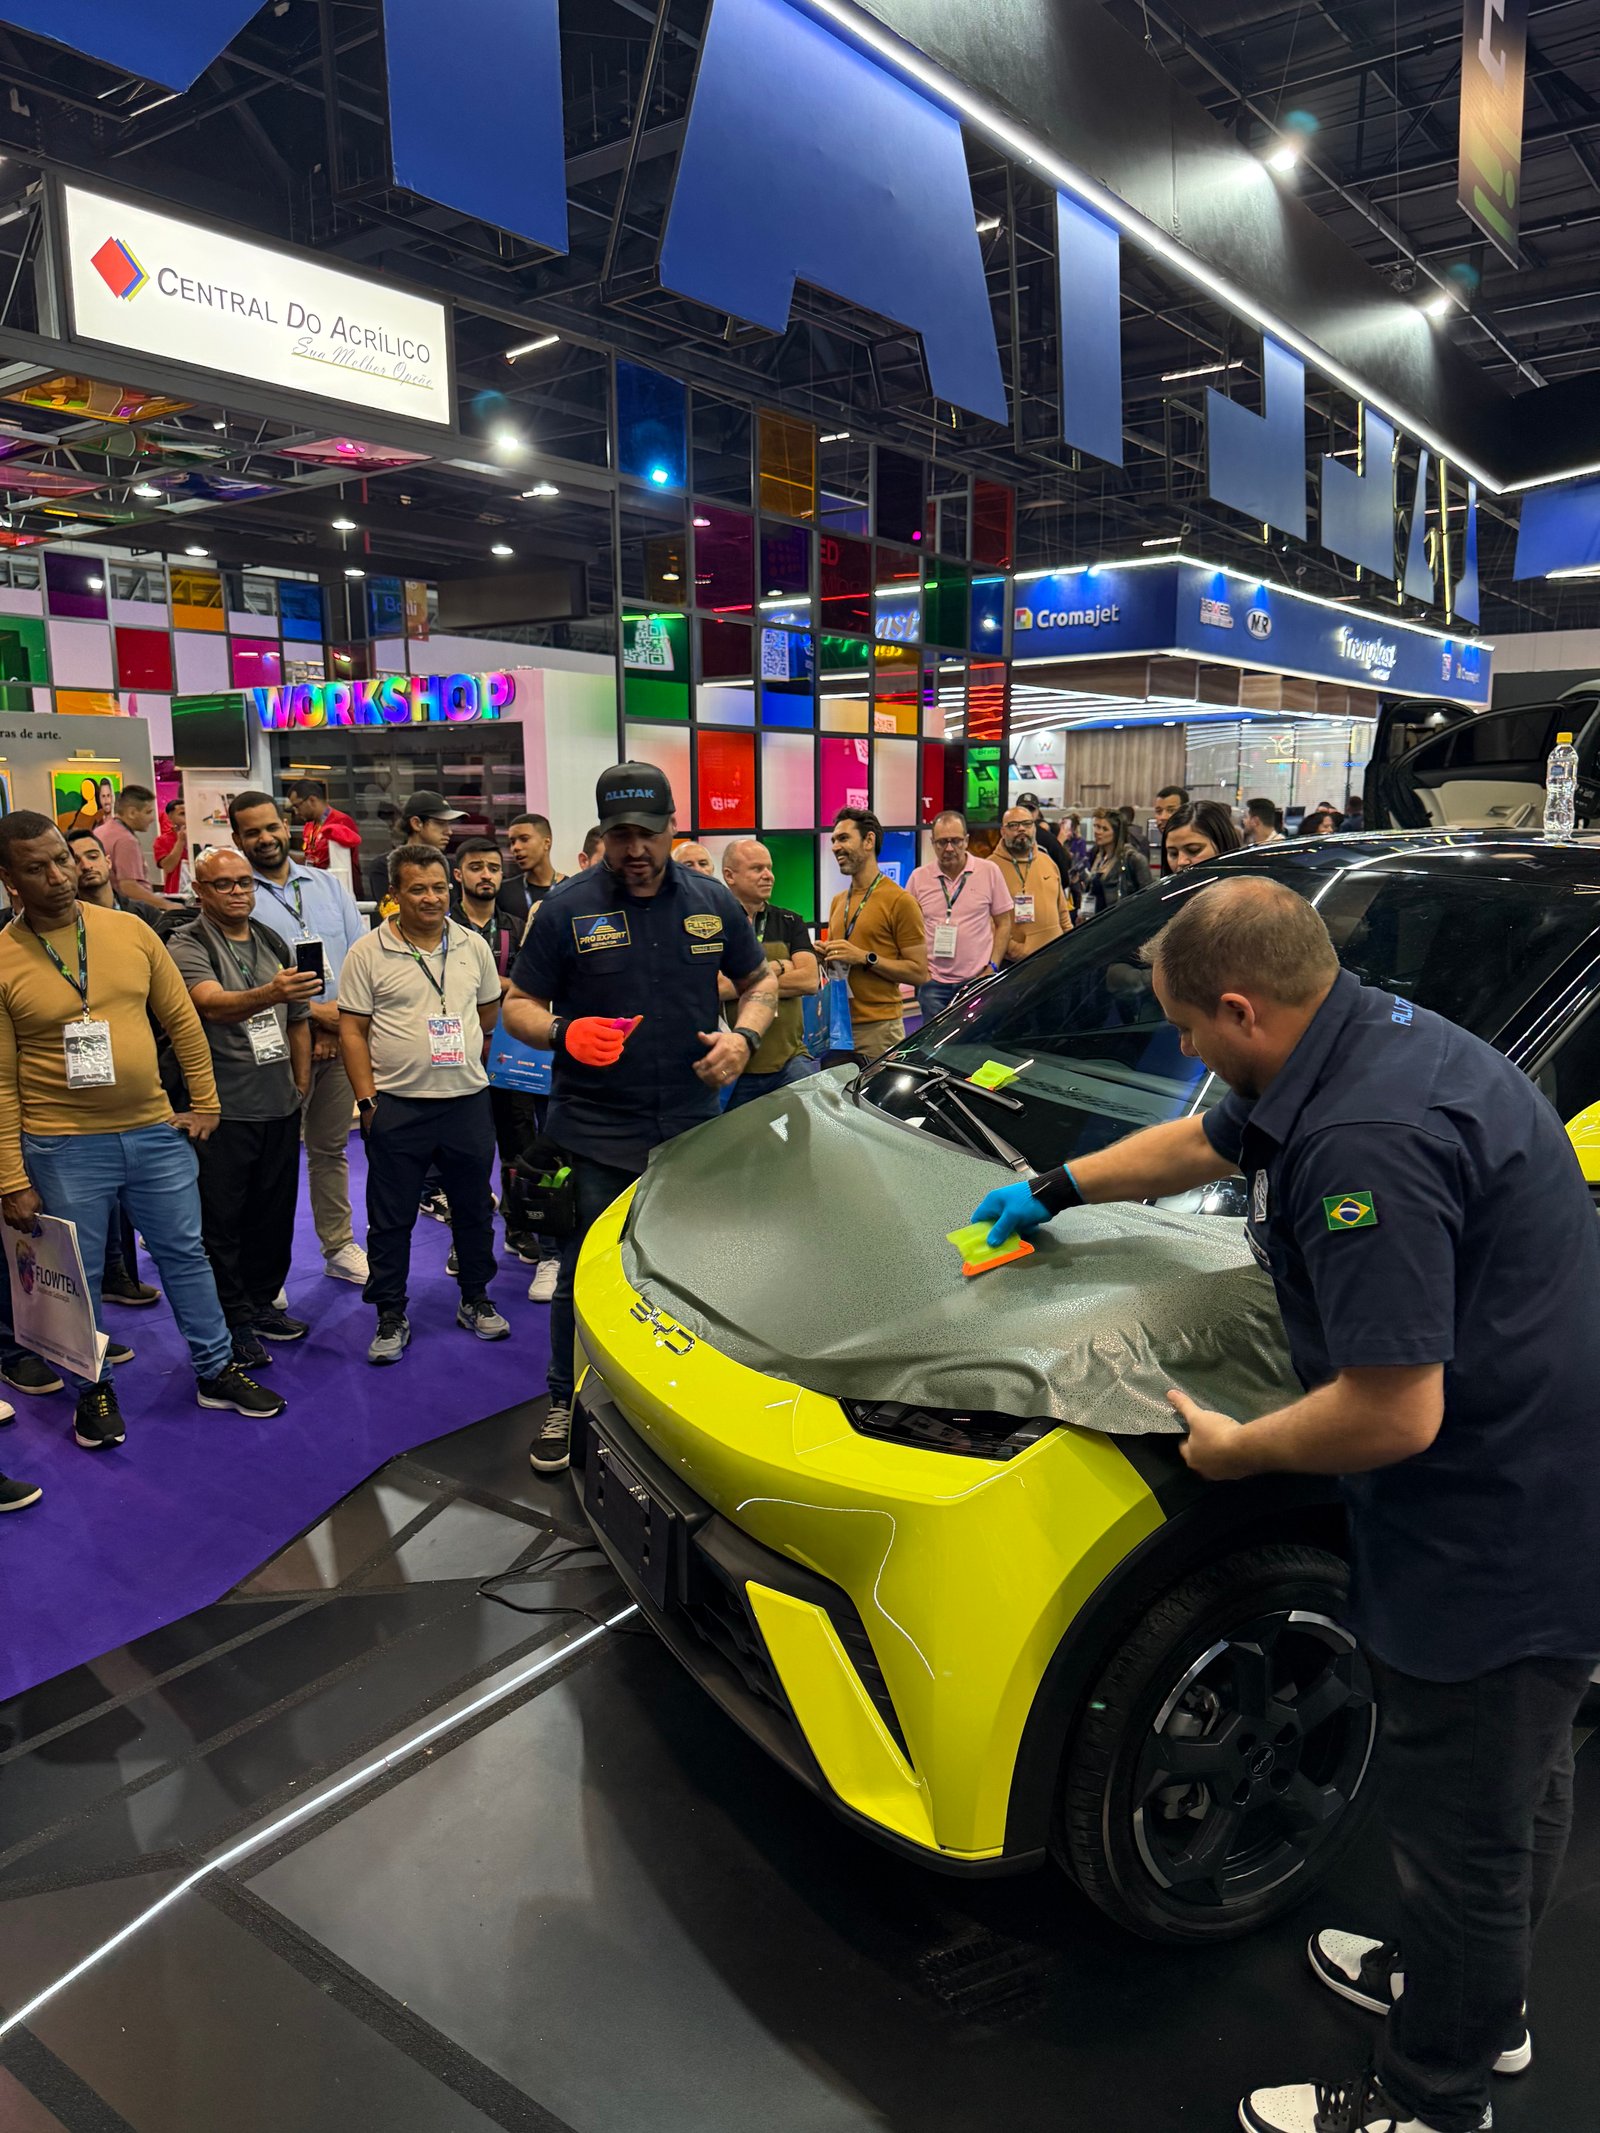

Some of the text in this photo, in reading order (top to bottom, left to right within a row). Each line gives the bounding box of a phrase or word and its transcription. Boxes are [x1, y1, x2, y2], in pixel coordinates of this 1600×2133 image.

[157, 267, 278, 324] CENTRAL
[330, 316, 431, 364] ACRÍLICO
[292, 336, 326, 360] Sua
[332, 345, 386, 375] Melhor
[1036, 603, 1120, 629] Cromajet
[252, 671, 517, 729] WORKSHOP
[20, 728, 33, 739] de
[36, 730, 62, 740] arte.
[604, 788, 656, 801] ALLTAK
[579, 935, 596, 945] PRO
[596, 931, 627, 942] EXPERT
[1391, 994, 1414, 1026] ALLT
